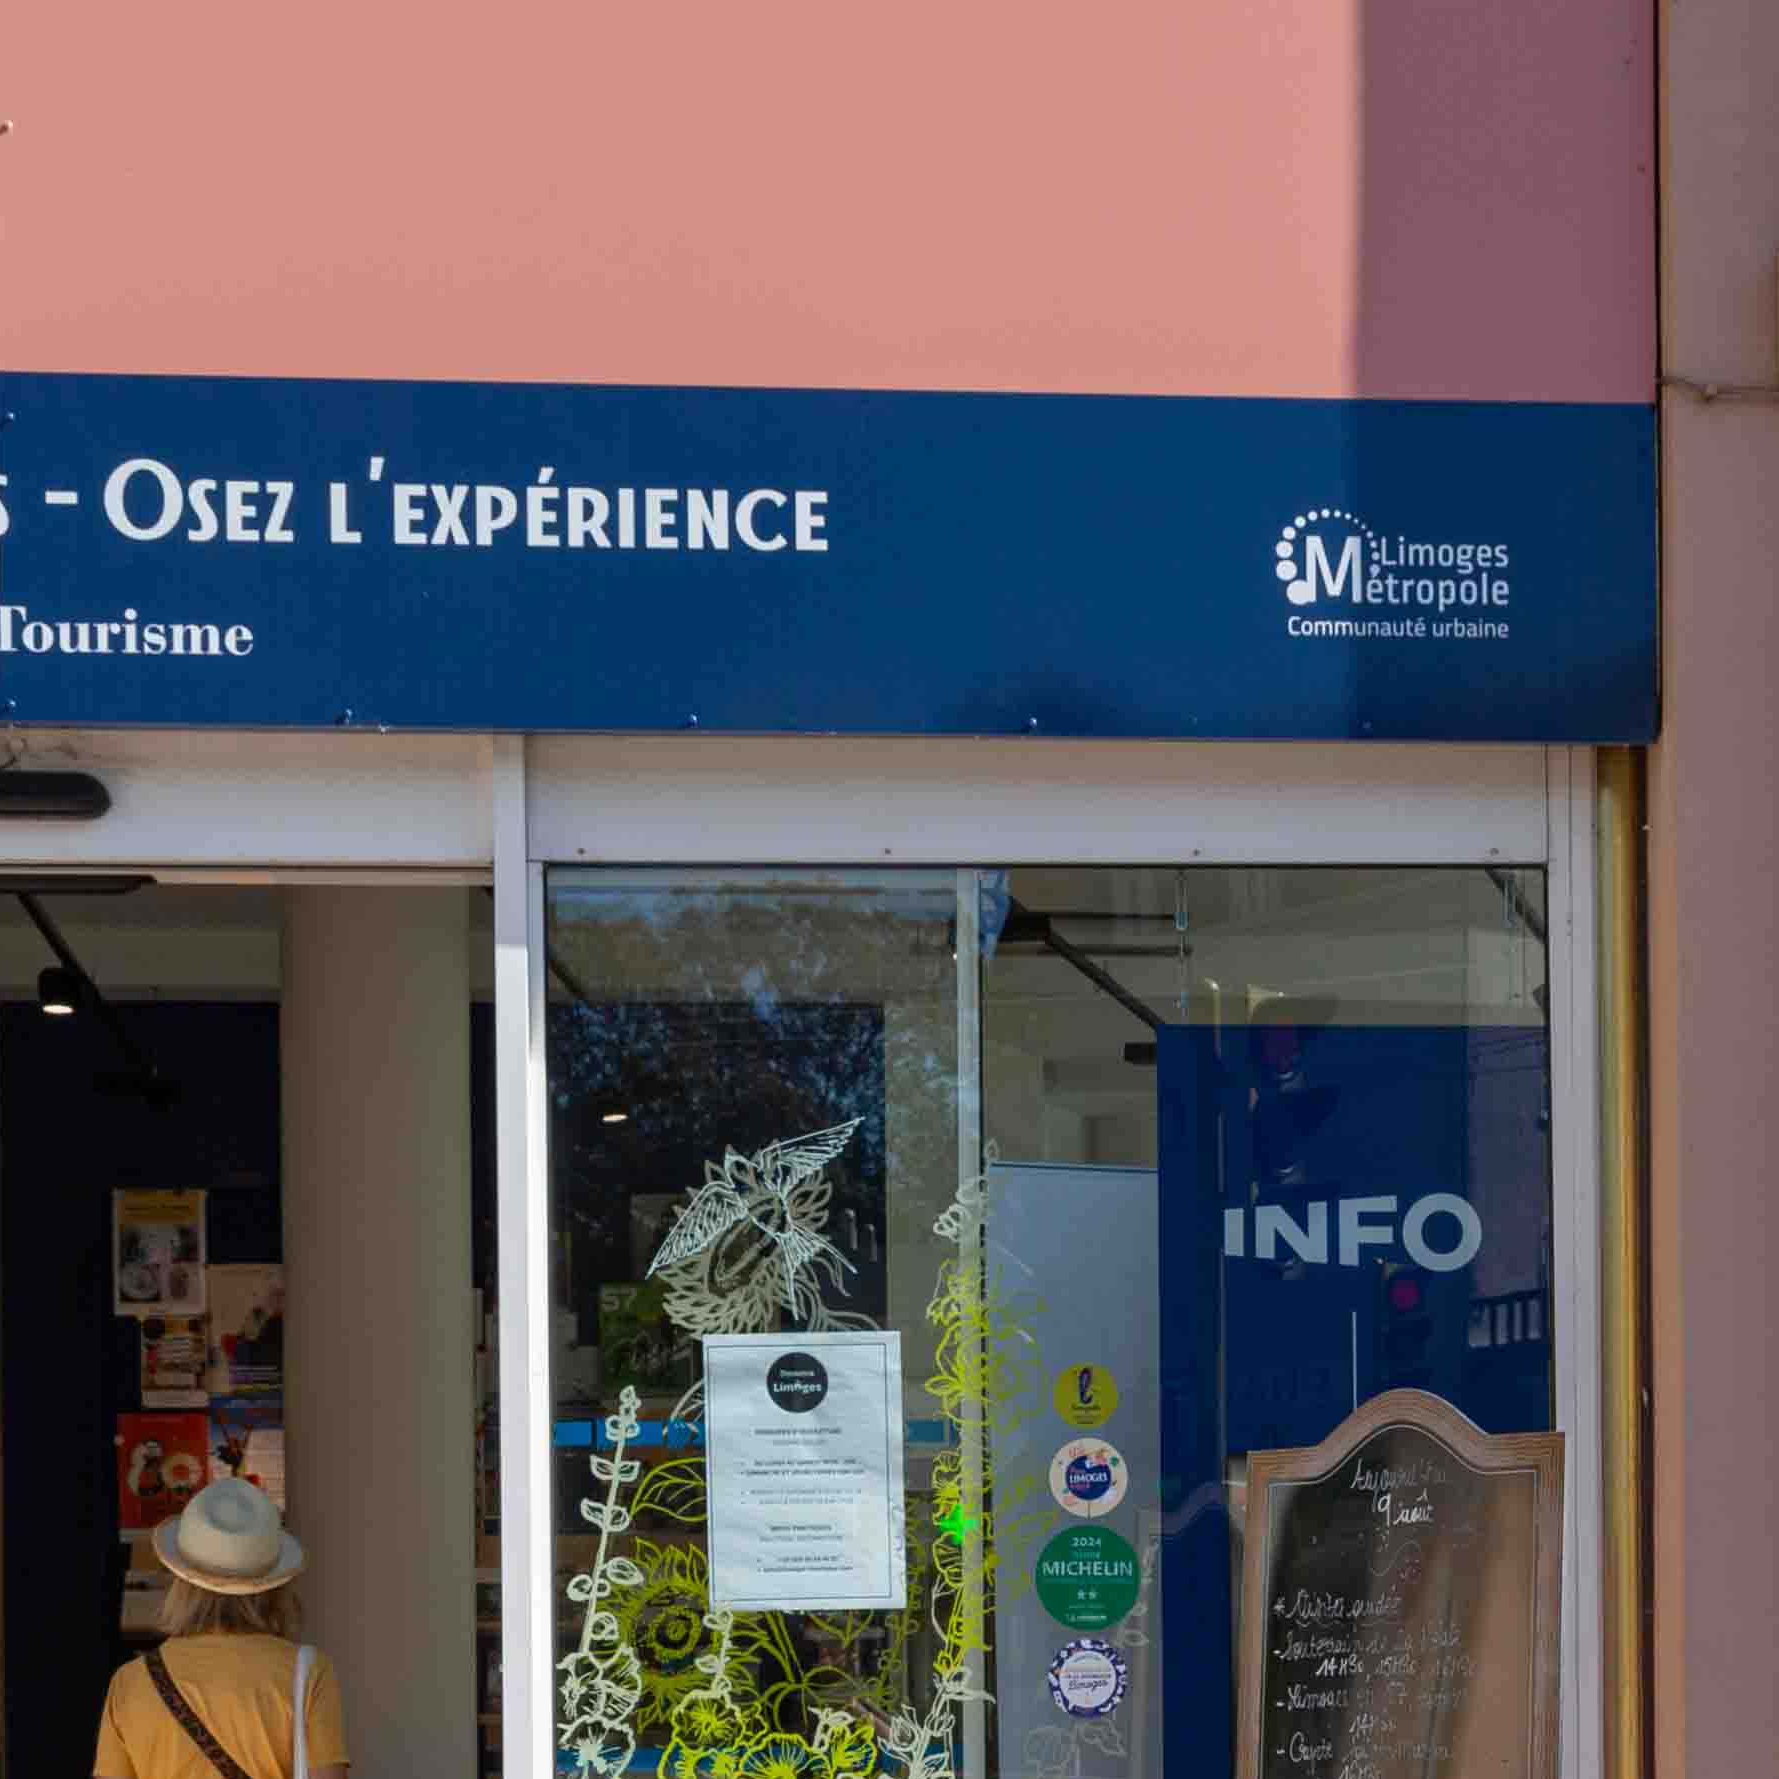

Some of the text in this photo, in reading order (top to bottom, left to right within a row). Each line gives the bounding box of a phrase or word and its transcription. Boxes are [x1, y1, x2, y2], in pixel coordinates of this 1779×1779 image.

[103, 457, 297, 544] OSEZ
[328, 455, 831, 552] L'EXPÉRIENCE
[1381, 535, 1510, 575] Limoges
[1287, 615, 1510, 639] Communauté urbaine
[1223, 1192, 1483, 1272] INFO
[1071, 1536, 1103, 1548] 2024
[1041, 1560, 1134, 1577] MICHELIN
